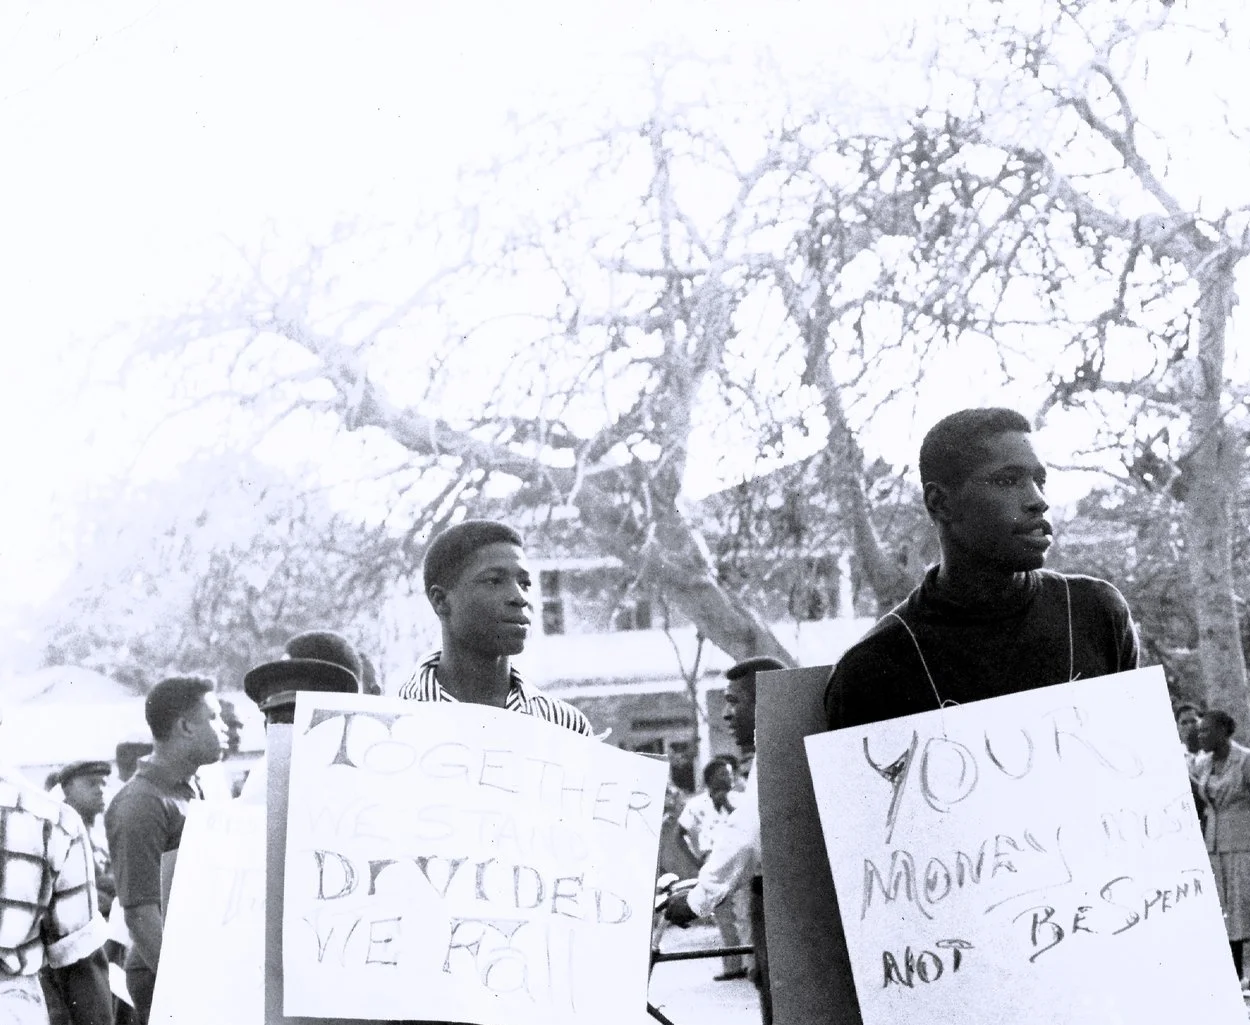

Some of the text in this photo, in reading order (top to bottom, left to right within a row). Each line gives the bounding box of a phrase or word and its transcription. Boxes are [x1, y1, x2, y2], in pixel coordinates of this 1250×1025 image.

[302, 706, 657, 838] TOGETHER
[306, 796, 390, 842] WE
[862, 705, 1144, 845] YOUR
[860, 825, 1073, 921] MONEY
[302, 907, 576, 1014] WE Fall
[881, 938, 975, 990] NOT
[1011, 904, 1095, 965] BE
